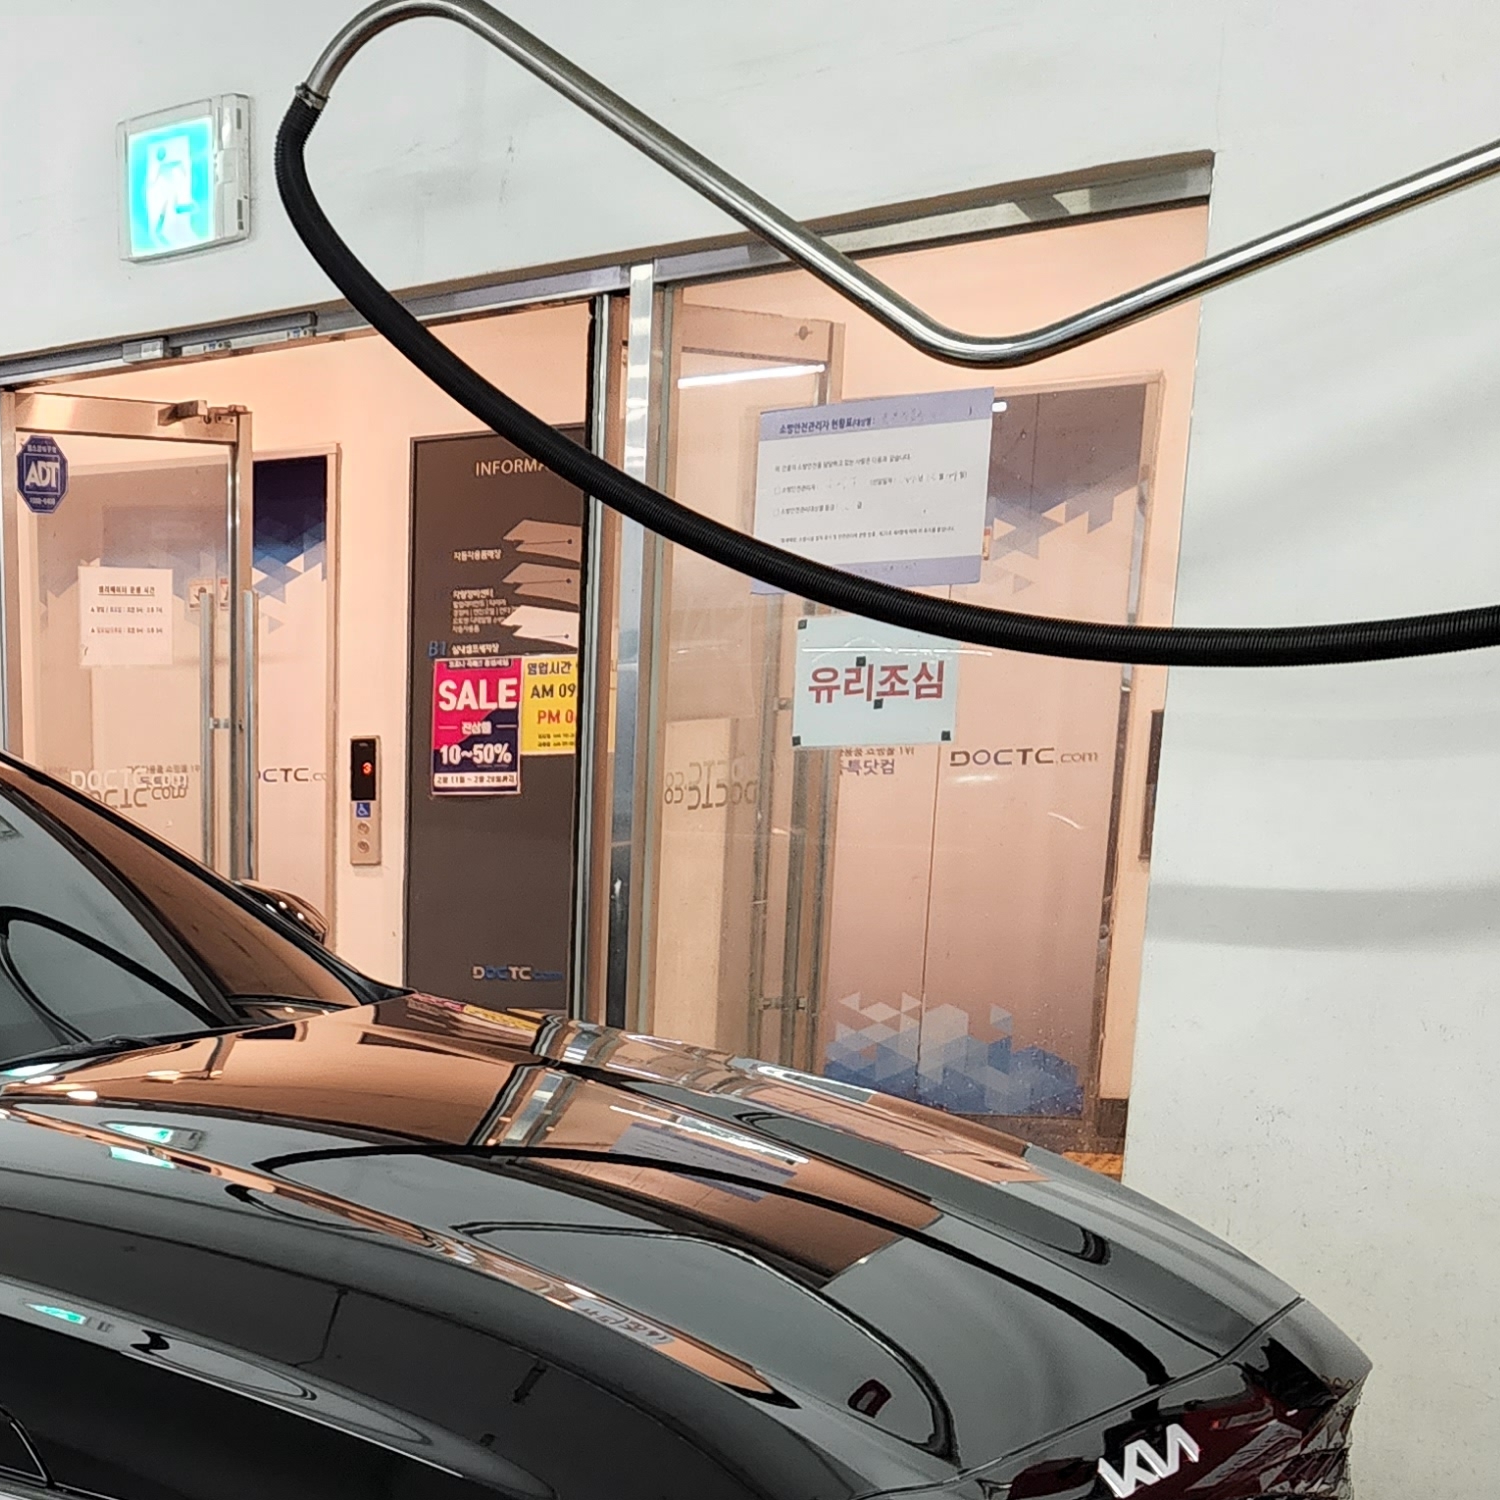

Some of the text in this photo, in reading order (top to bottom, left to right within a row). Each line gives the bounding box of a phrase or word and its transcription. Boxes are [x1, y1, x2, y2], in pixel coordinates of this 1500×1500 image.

[25, 460, 60, 488] ADT
[527, 661, 572, 675] 영업시간
[530, 684, 554, 699] AM
[808, 660, 945, 703] 유리조심
[438, 678, 518, 711] SALE
[537, 710, 561, 724] PM
[440, 743, 512, 765] 10~50%
[950, 747, 1099, 767] DOCTC.com
[362, 762, 373, 775] 3
